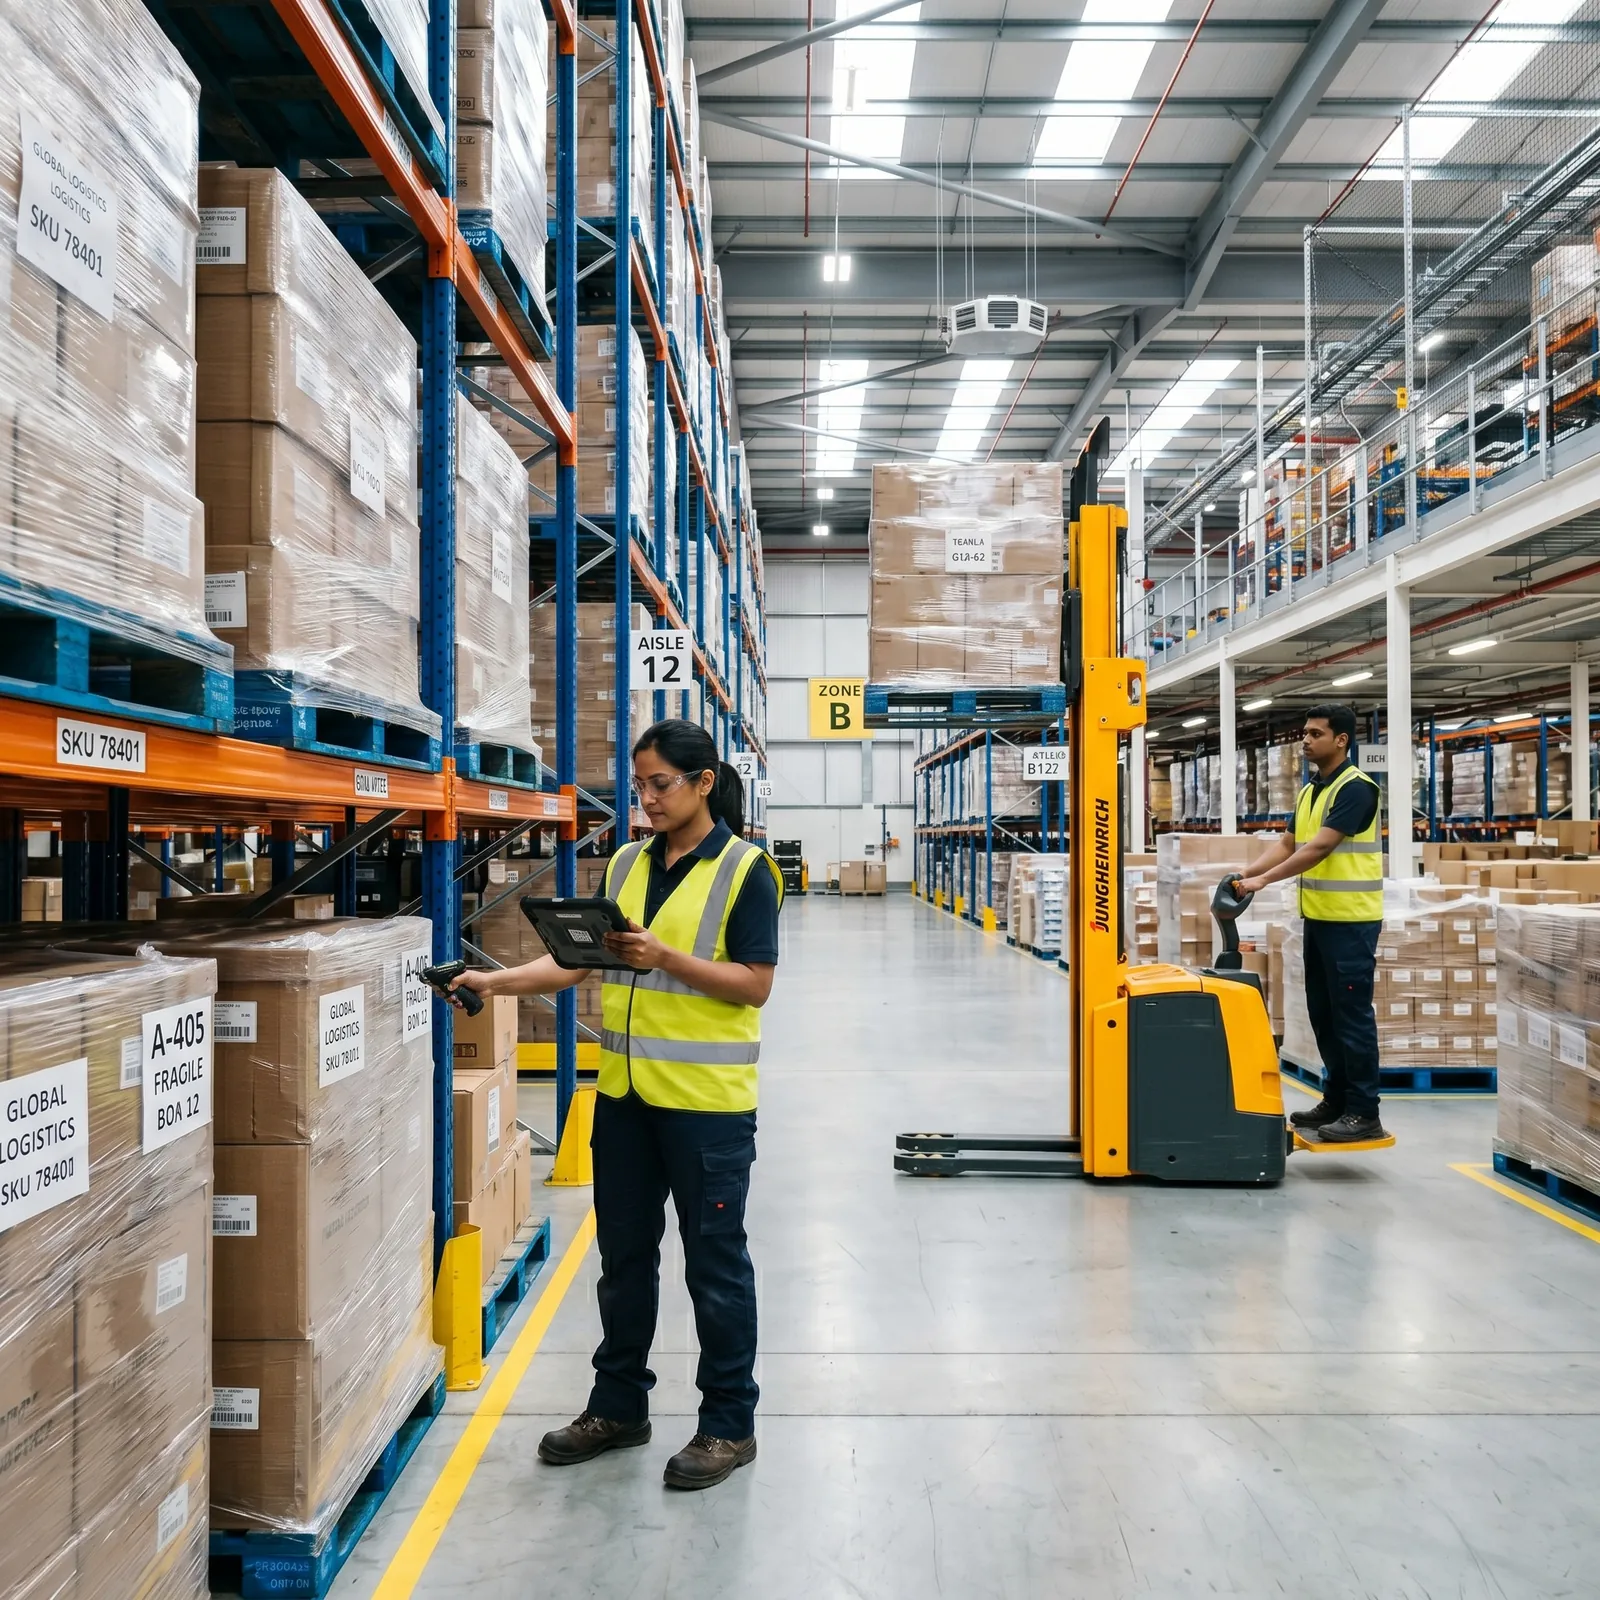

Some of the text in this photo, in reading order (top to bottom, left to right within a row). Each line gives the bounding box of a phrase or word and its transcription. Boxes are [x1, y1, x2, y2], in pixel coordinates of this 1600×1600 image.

[33, 141, 107, 213] GLOBAL LOGISTICS
[50, 181, 91, 224] LOGISTICS
[30, 203, 103, 278] SKU 78401
[637, 636, 684, 650] AISLE
[642, 655, 681, 683] 12
[818, 684, 861, 697] ZONE
[830, 702, 851, 730] B
[61, 728, 139, 763] SKU 78401
[1092, 798, 1109, 933] JUNGHEINRICH
[330, 999, 356, 1020] GLOBAL
[151, 1010, 205, 1060] A-405
[325, 1020, 360, 1046] LOGISTICS
[154, 1057, 203, 1096] FRAGILE
[326, 1053, 340, 1072] SKU
[7, 1084, 67, 1123] GLOBAL
[186, 1093, 200, 1118] 12
[0, 1117, 75, 1165] LOGISTICS
[1, 1174, 31, 1206] SKU
